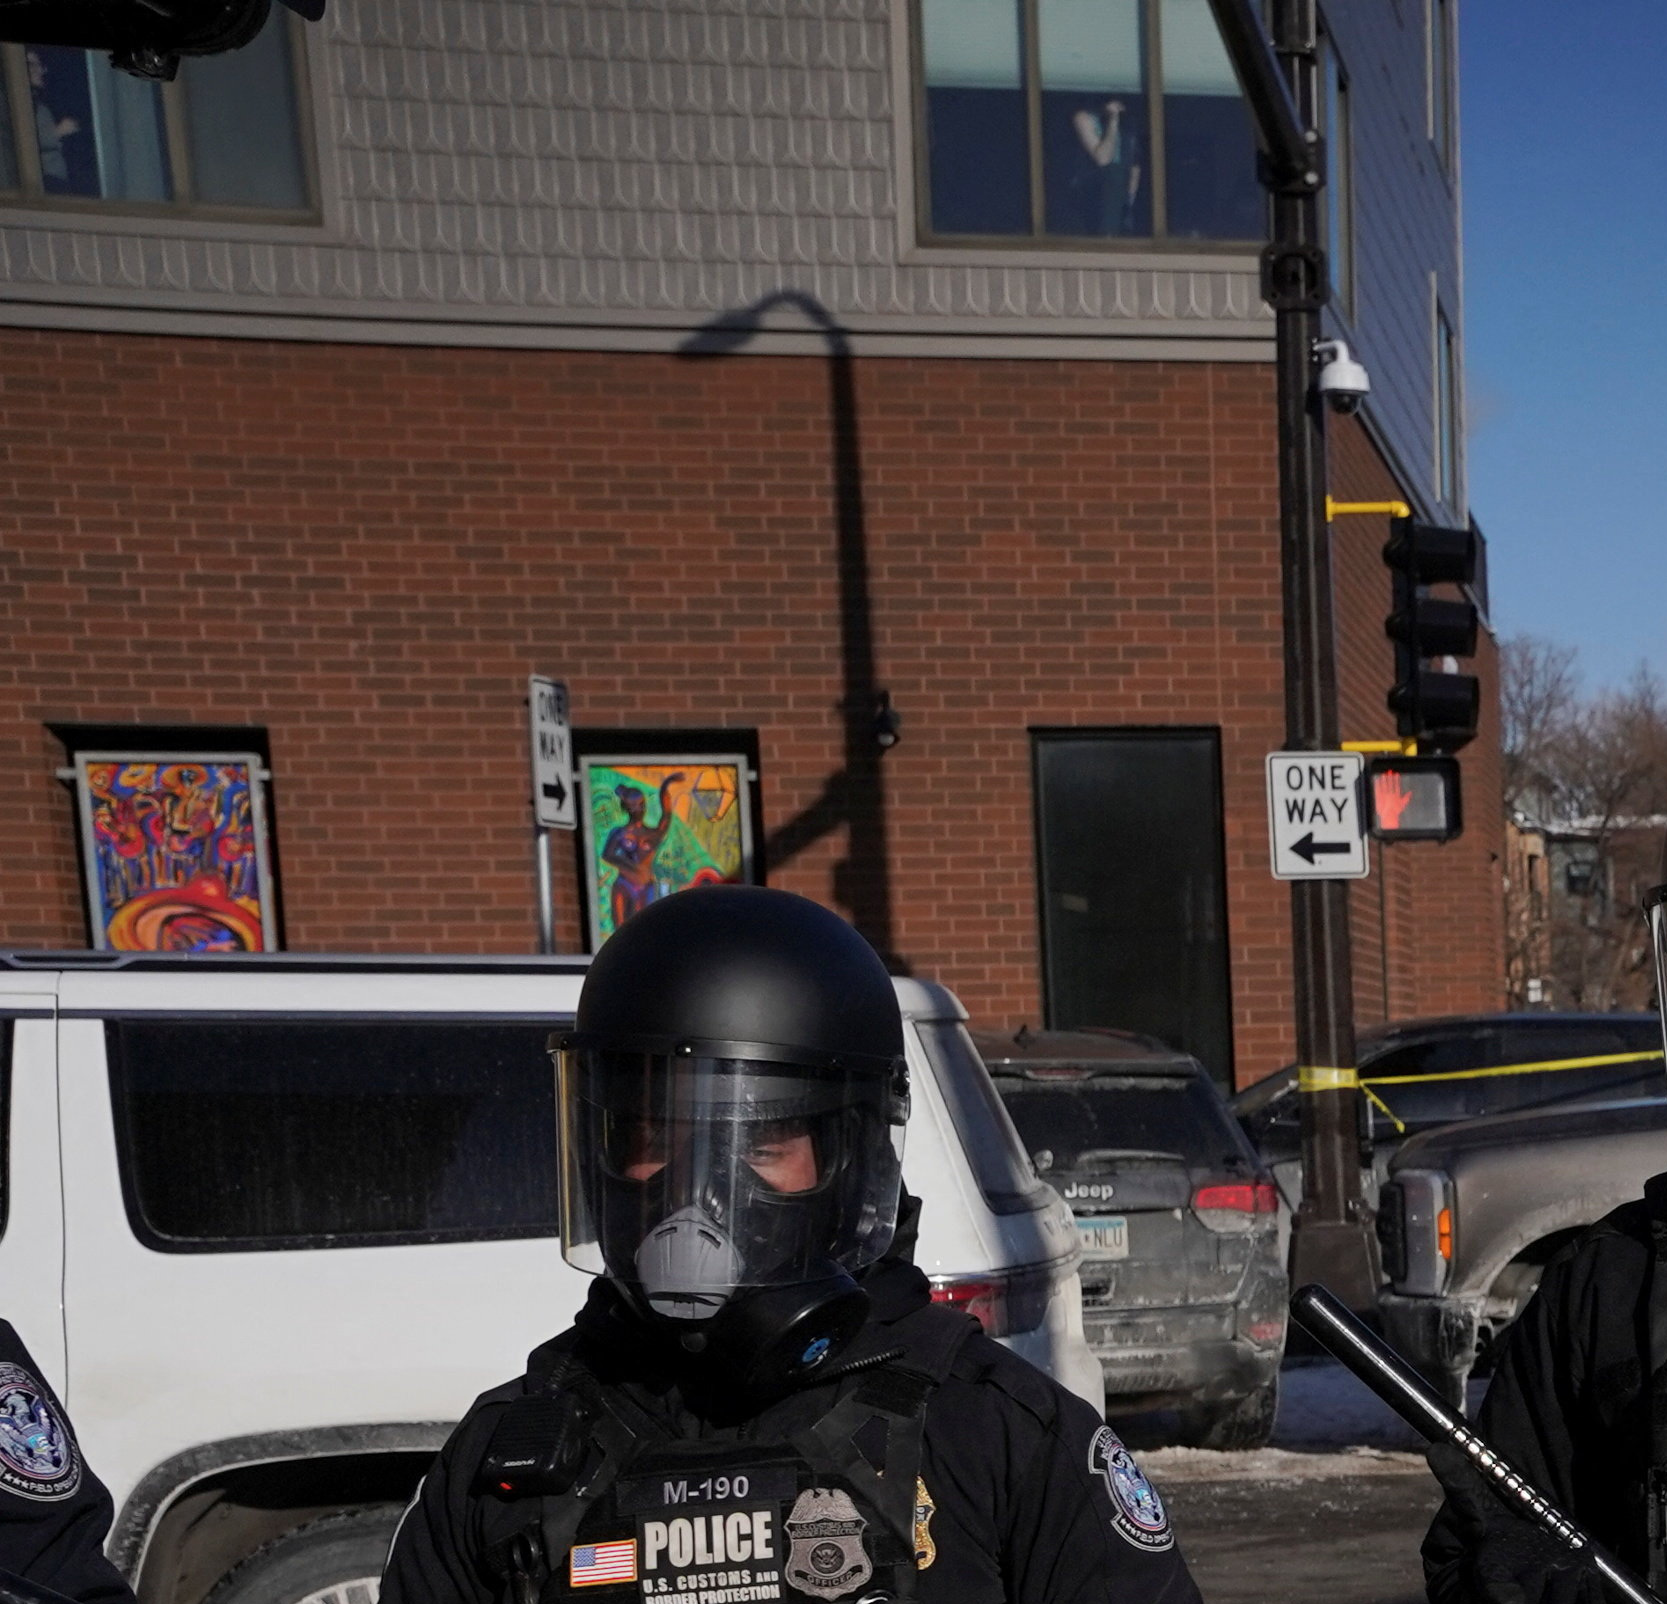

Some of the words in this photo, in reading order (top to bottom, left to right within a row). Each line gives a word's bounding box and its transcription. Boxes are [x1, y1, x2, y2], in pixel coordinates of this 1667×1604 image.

[1286, 764, 1346, 791] ONE
[1285, 797, 1348, 824] WAY
[1064, 1181, 1114, 1201] Jeep
[663, 1475, 750, 1505] M-190
[643, 1510, 775, 1570] POLICE
[642, 1577, 673, 1594] U.S.
[676, 1569, 752, 1591] CUSTOMS
[755, 1570, 780, 1584] AND
[807, 1571, 852, 1587] OFFICER
